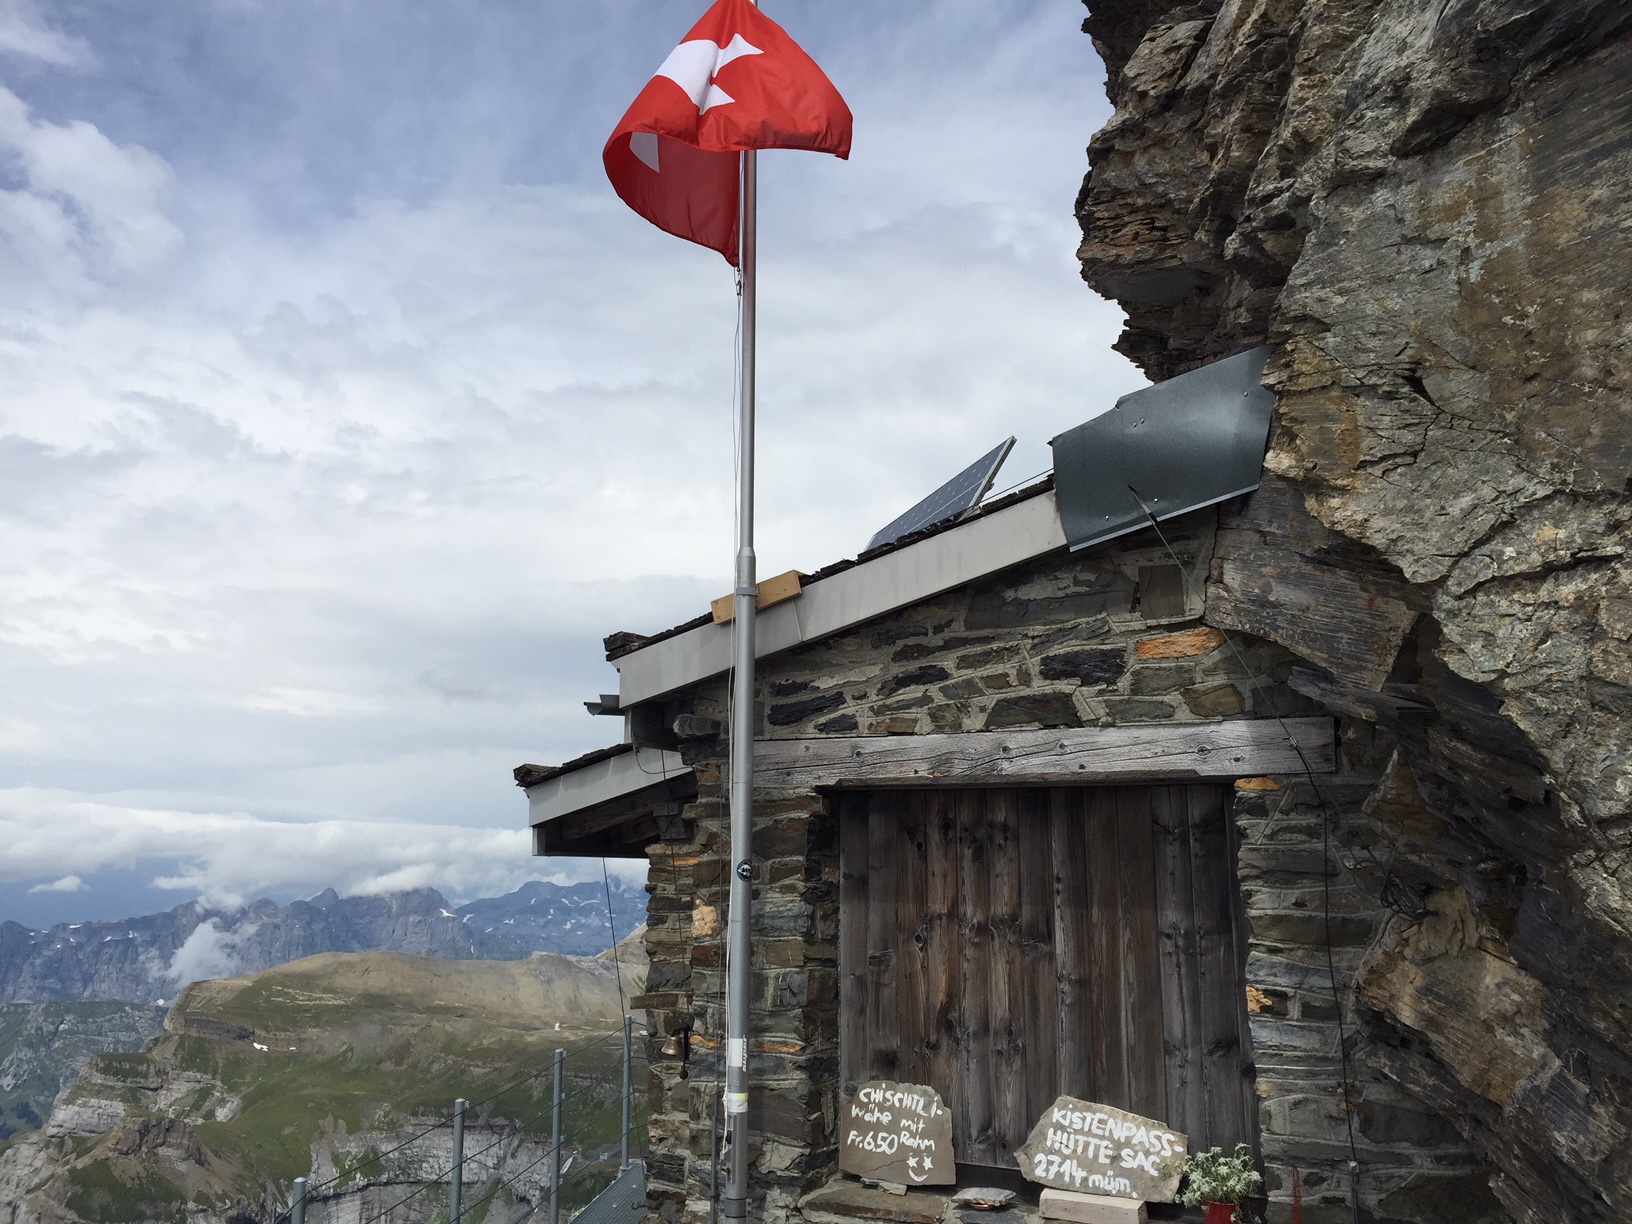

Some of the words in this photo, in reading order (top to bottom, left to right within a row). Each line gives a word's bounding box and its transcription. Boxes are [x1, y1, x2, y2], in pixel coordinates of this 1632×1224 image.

[900, 1117, 926, 1133] mit
[900, 1131, 936, 1151] Rahm
[1046, 1128, 1114, 1164] HÜTTE
[1119, 1148, 1160, 1177] SAC
[1034, 1152, 1087, 1188] 2714
